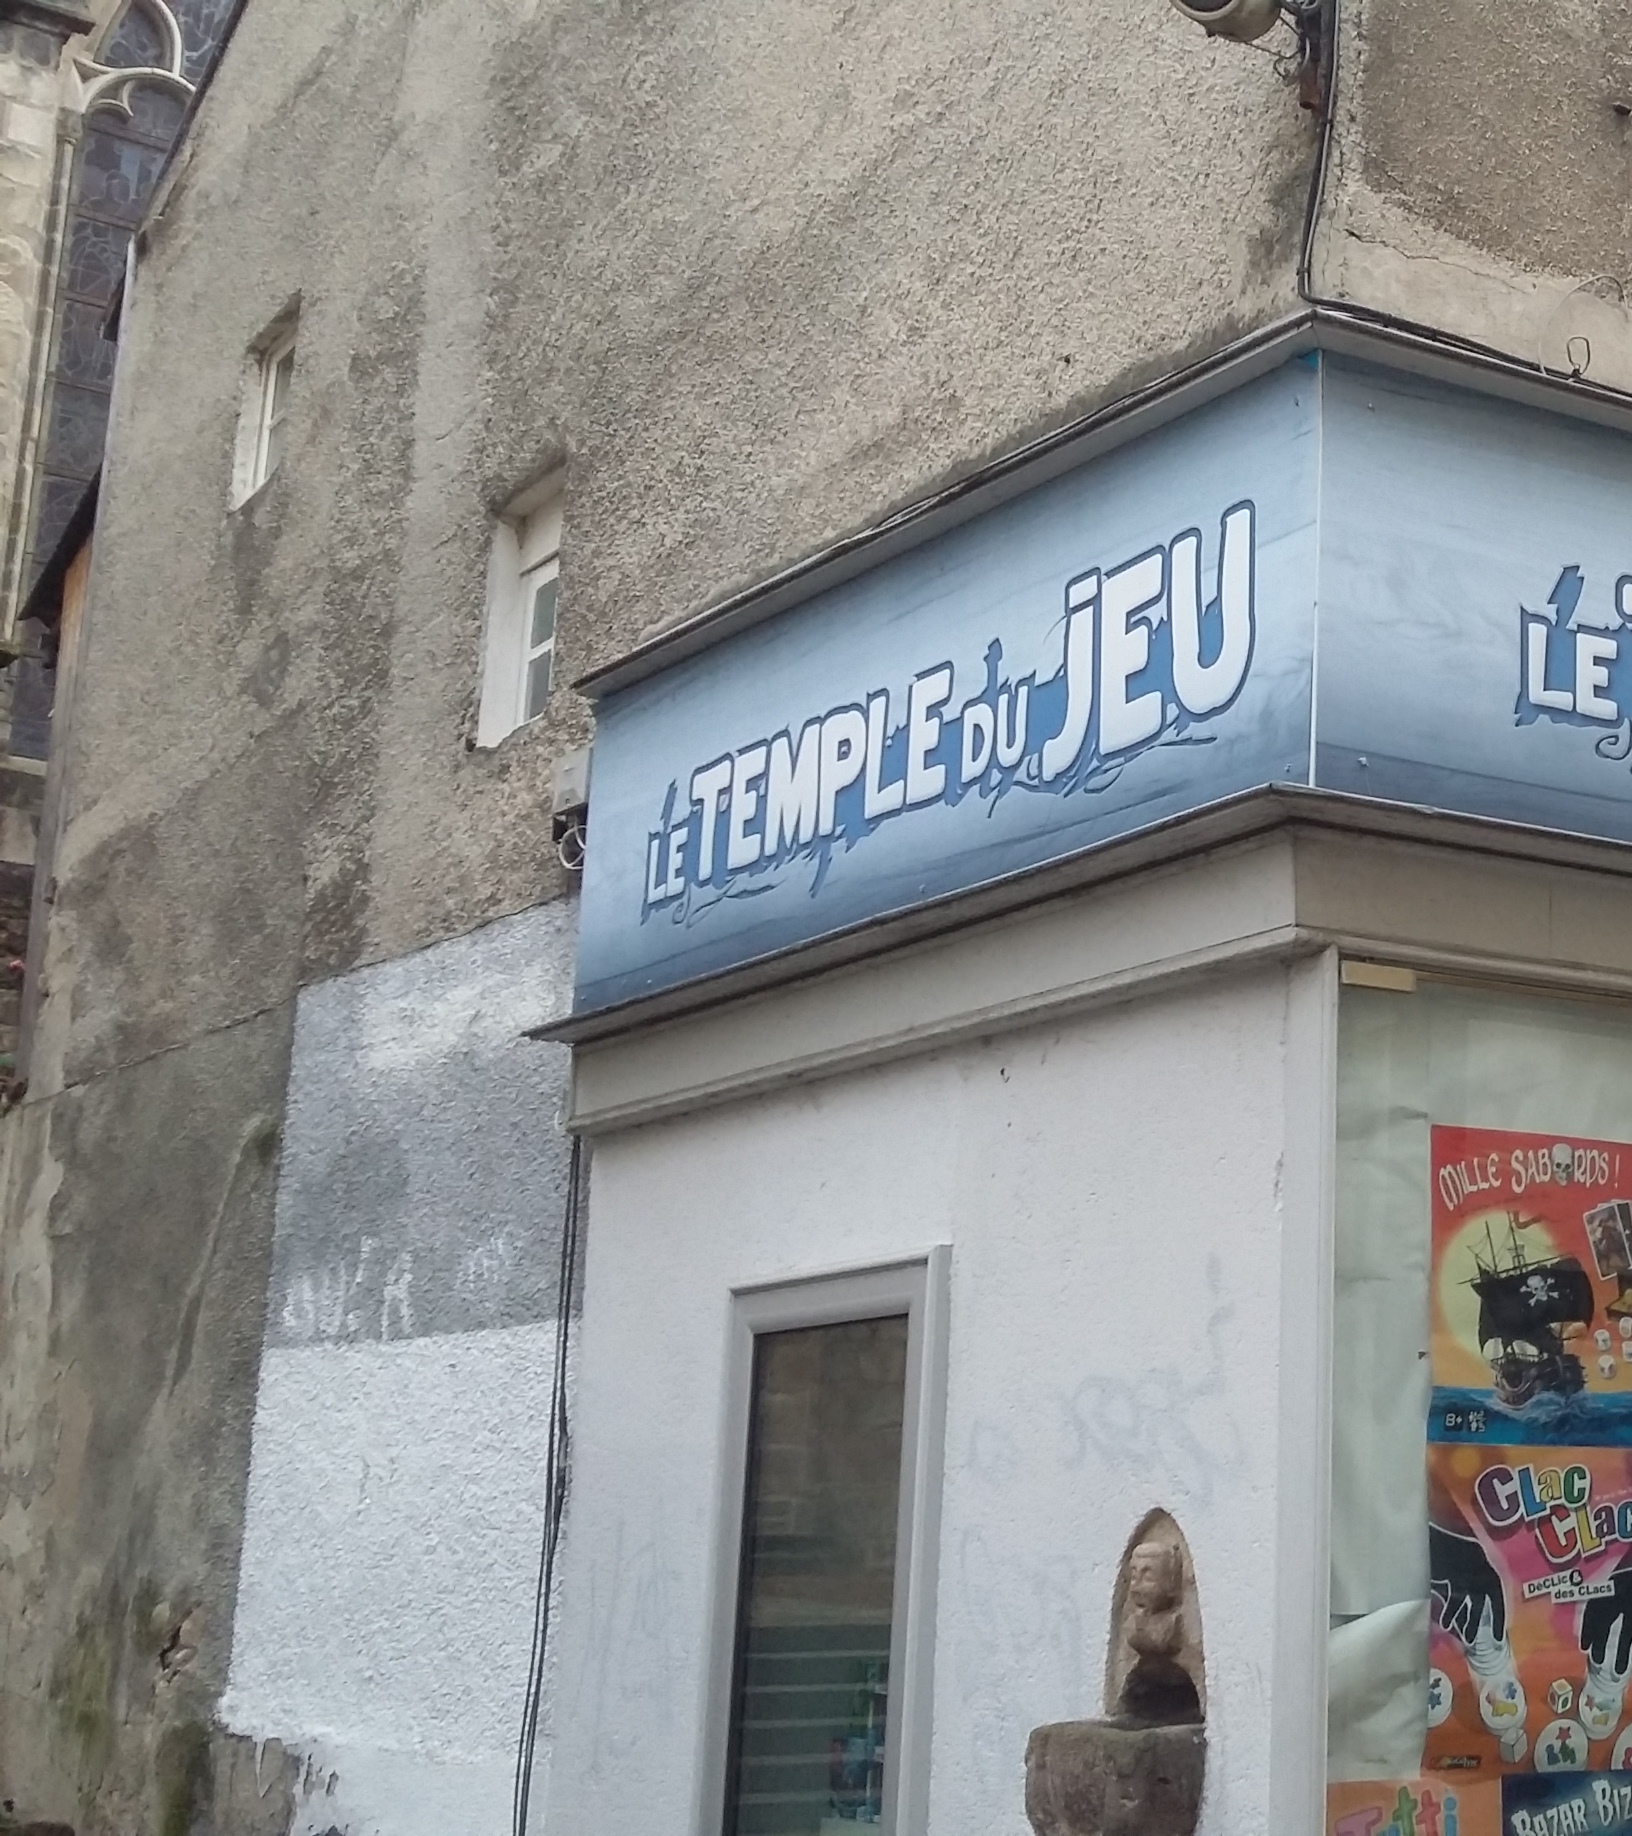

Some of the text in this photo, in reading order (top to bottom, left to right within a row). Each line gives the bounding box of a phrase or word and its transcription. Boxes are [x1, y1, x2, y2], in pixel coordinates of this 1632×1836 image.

[1525, 618, 1620, 722] LE
[646, 824, 687, 905] LE
[692, 662, 954, 882] TEMPLE
[960, 684, 1028, 786] DU
[1438, 1152, 1502, 1212] MILLE
[1554, 1588, 1575, 1600] des
[1511, 1798, 1589, 1836] BAZAR
